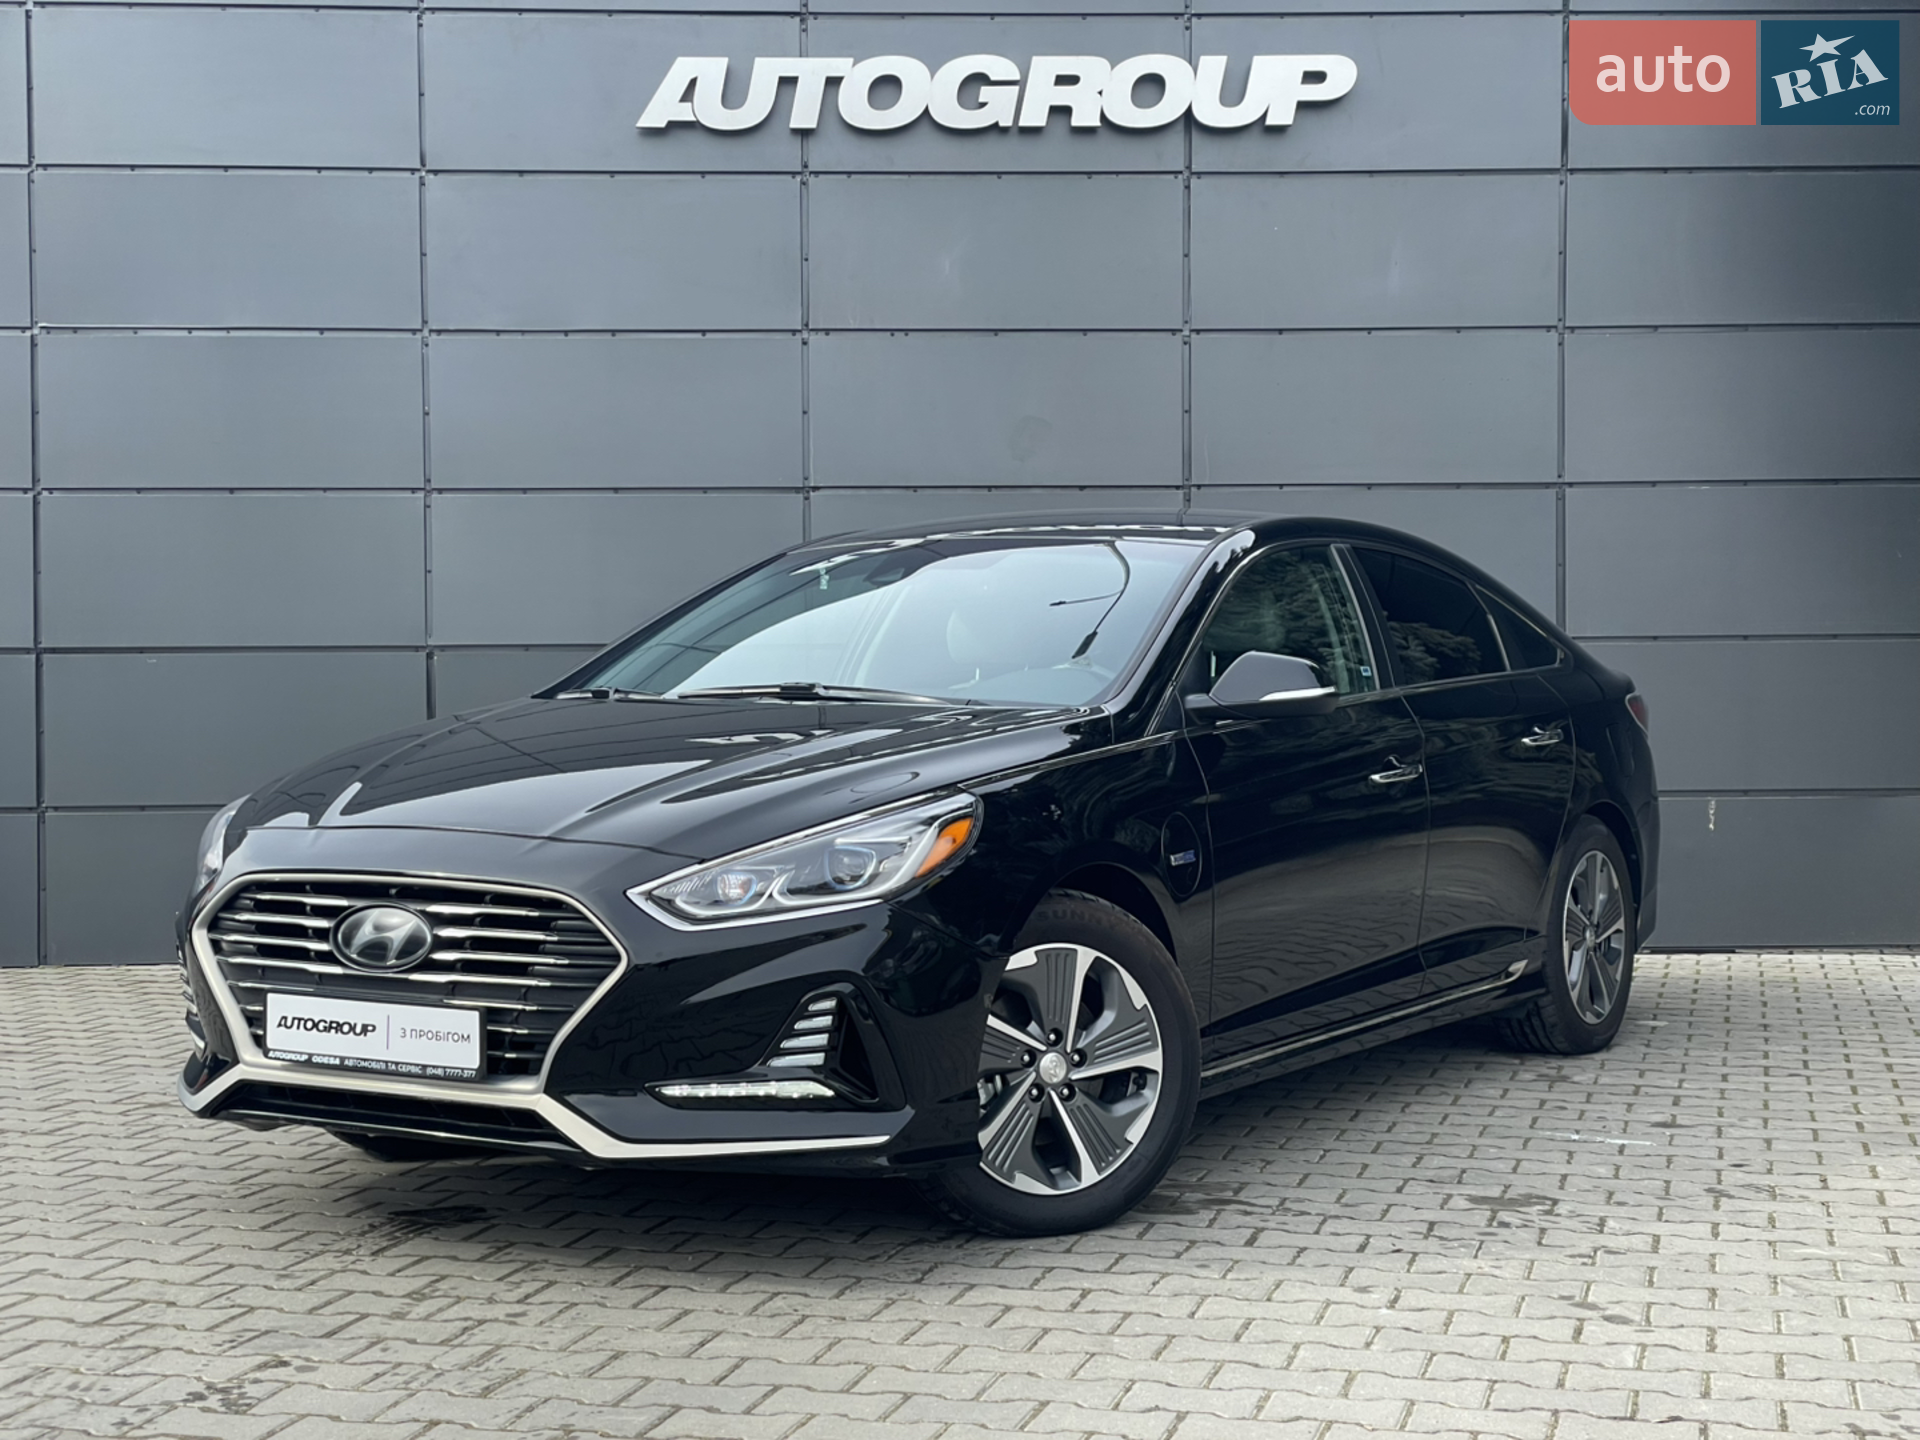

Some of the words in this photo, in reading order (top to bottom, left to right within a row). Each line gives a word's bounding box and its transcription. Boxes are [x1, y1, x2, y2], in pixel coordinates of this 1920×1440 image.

[635, 53, 1359, 131] AUTOGROUP
[276, 1015, 377, 1038] AUTOGROUP
[409, 1028, 471, 1044] ПРОБІГОМ
[268, 1050, 309, 1062] AUTOGROUP
[398, 1063, 422, 1074] СЕРВІС
[426, 1067, 445, 1077] (048)
